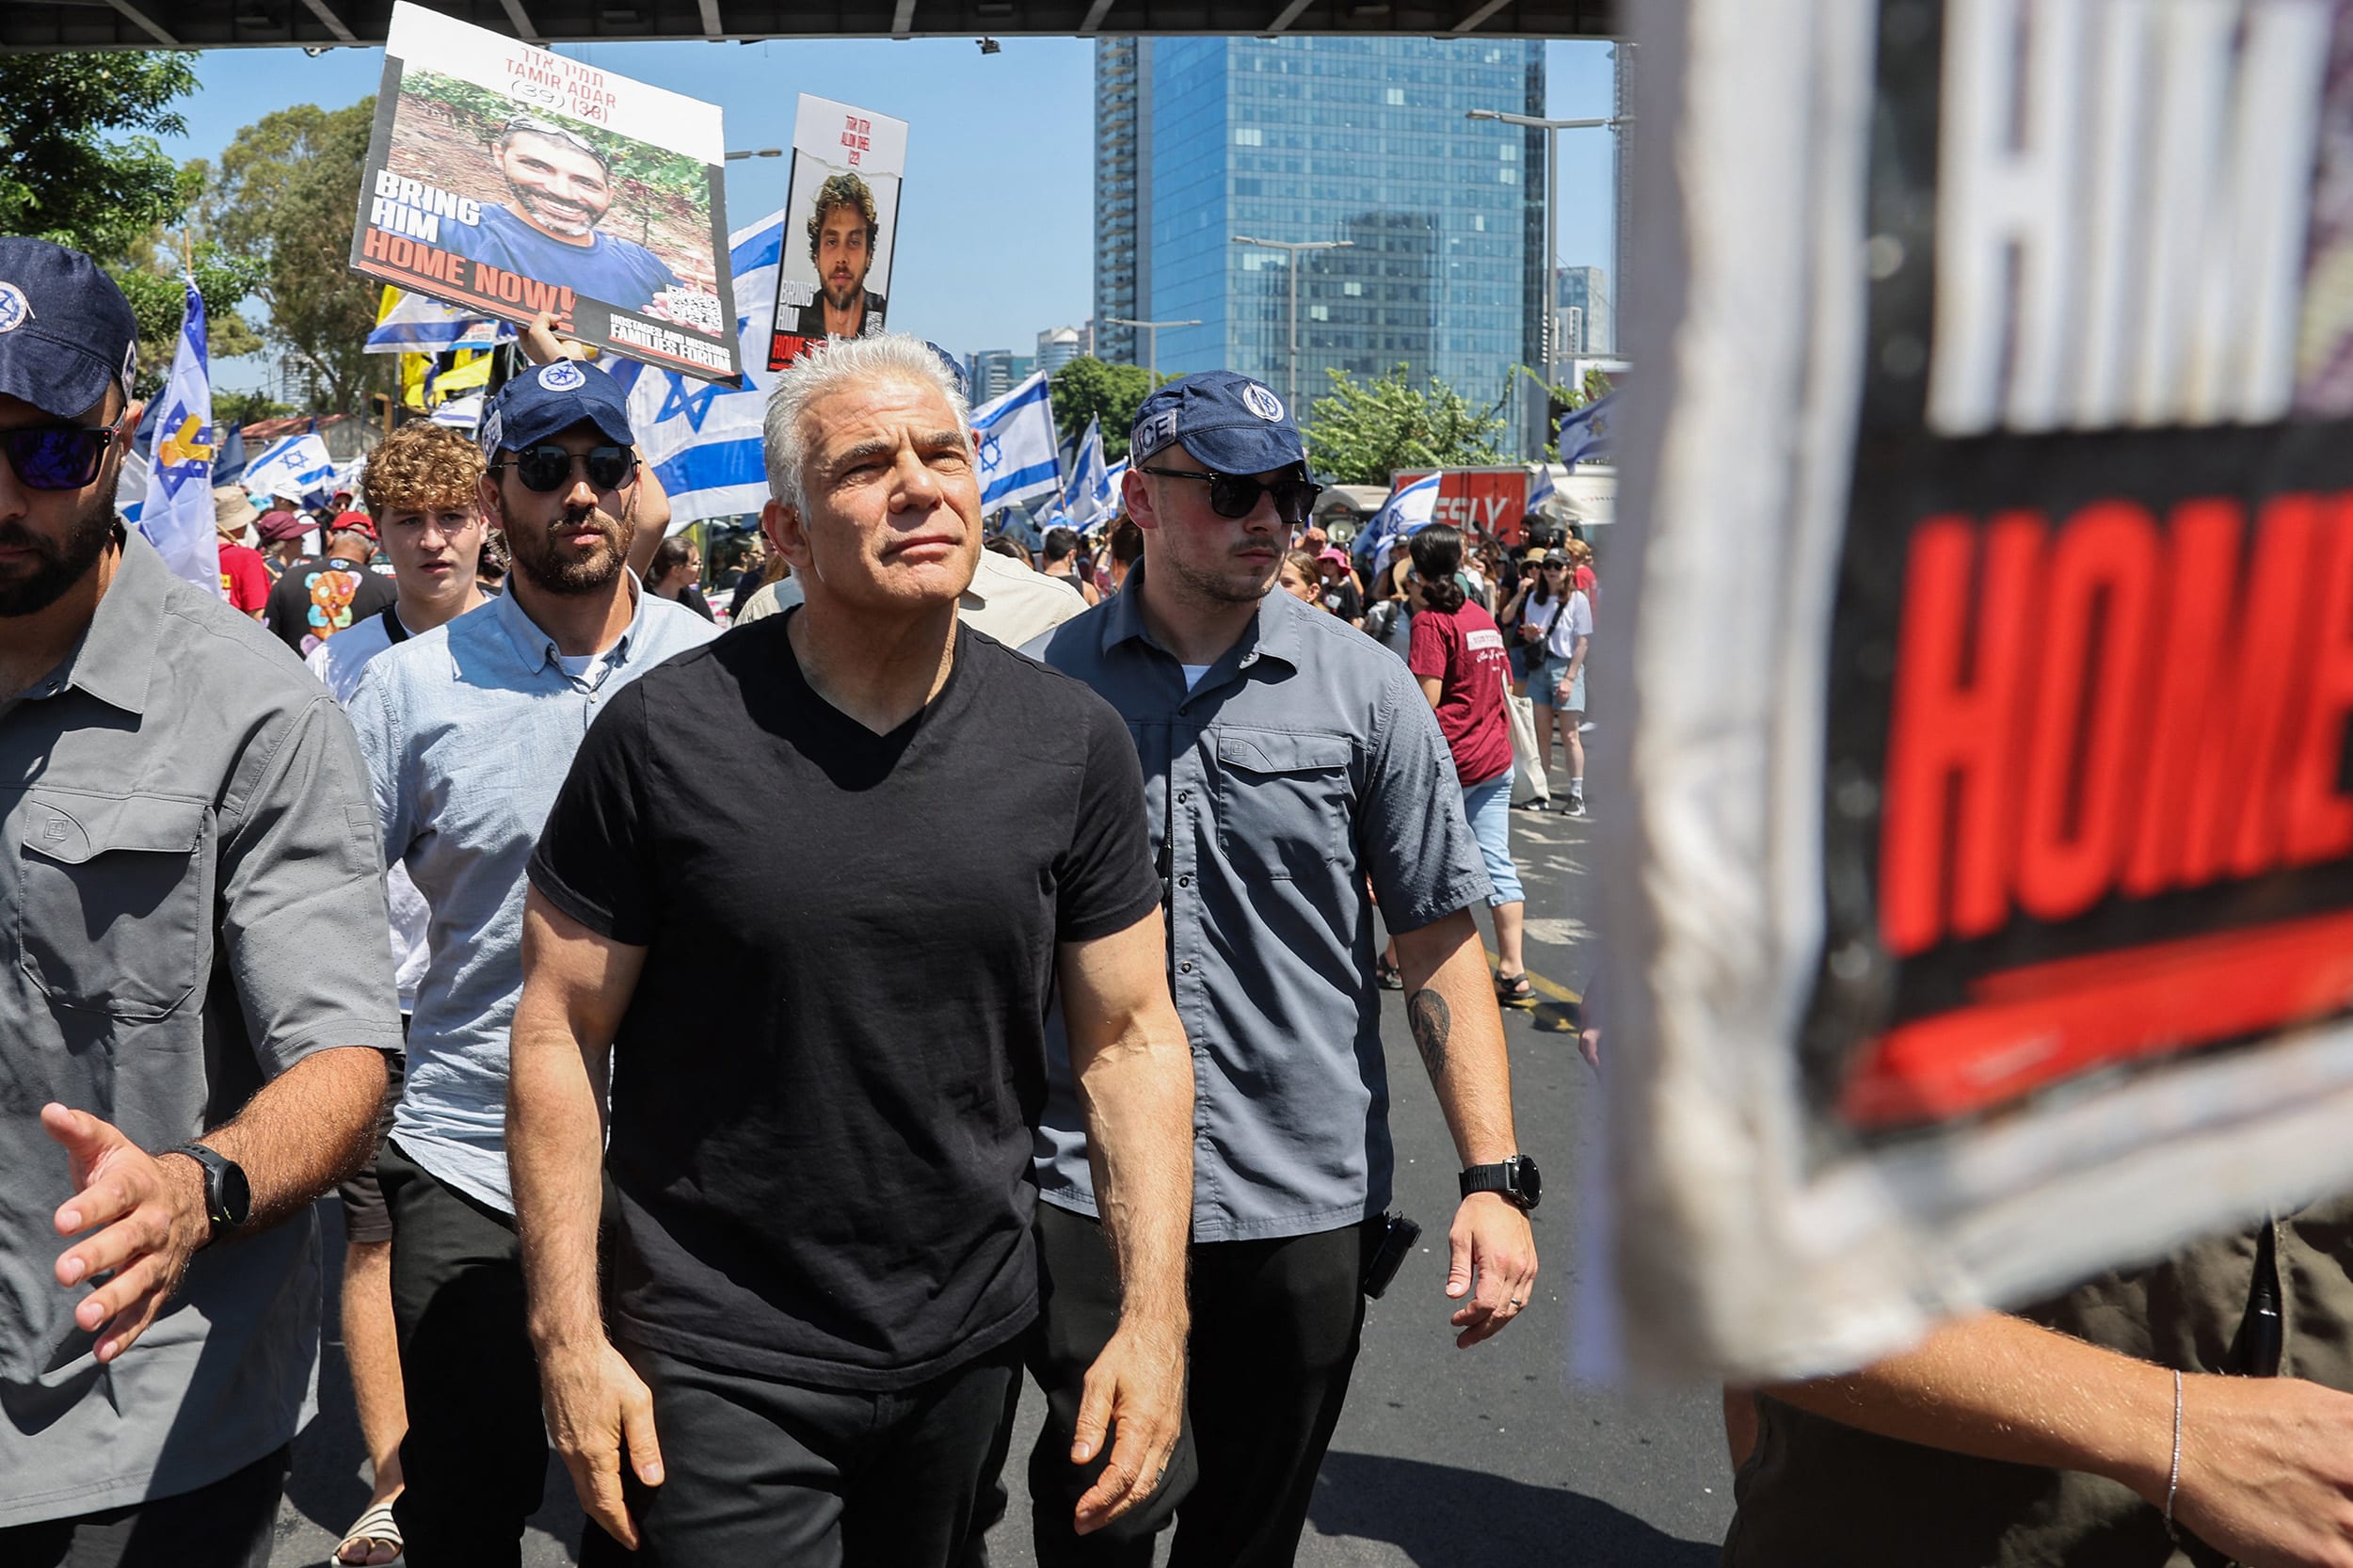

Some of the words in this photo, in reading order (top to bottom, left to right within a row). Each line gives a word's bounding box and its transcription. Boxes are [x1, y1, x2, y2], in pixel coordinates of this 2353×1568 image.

[505, 58, 561, 90] TAMIR
[568, 81, 616, 109] ADAR
[520, 48, 554, 72] אדר
[561, 61, 603, 88] תמיר
[511, 80, 565, 108] (39)
[370, 197, 440, 244] HIM
[375, 169, 481, 227] BRING
[1925, 0, 2332, 438] HIM
[362, 227, 467, 287] HOME
[474, 263, 578, 320] NOW!
[779, 279, 814, 308] BRING
[610, 312, 663, 339] HOSTAGES
[664, 328, 684, 345] AND
[685, 335, 730, 359] MISSING
[776, 304, 800, 332] HIM
[610, 323, 678, 357] FAMILIES
[680, 343, 732, 373] FORUM
[772, 334, 807, 360] HOME
